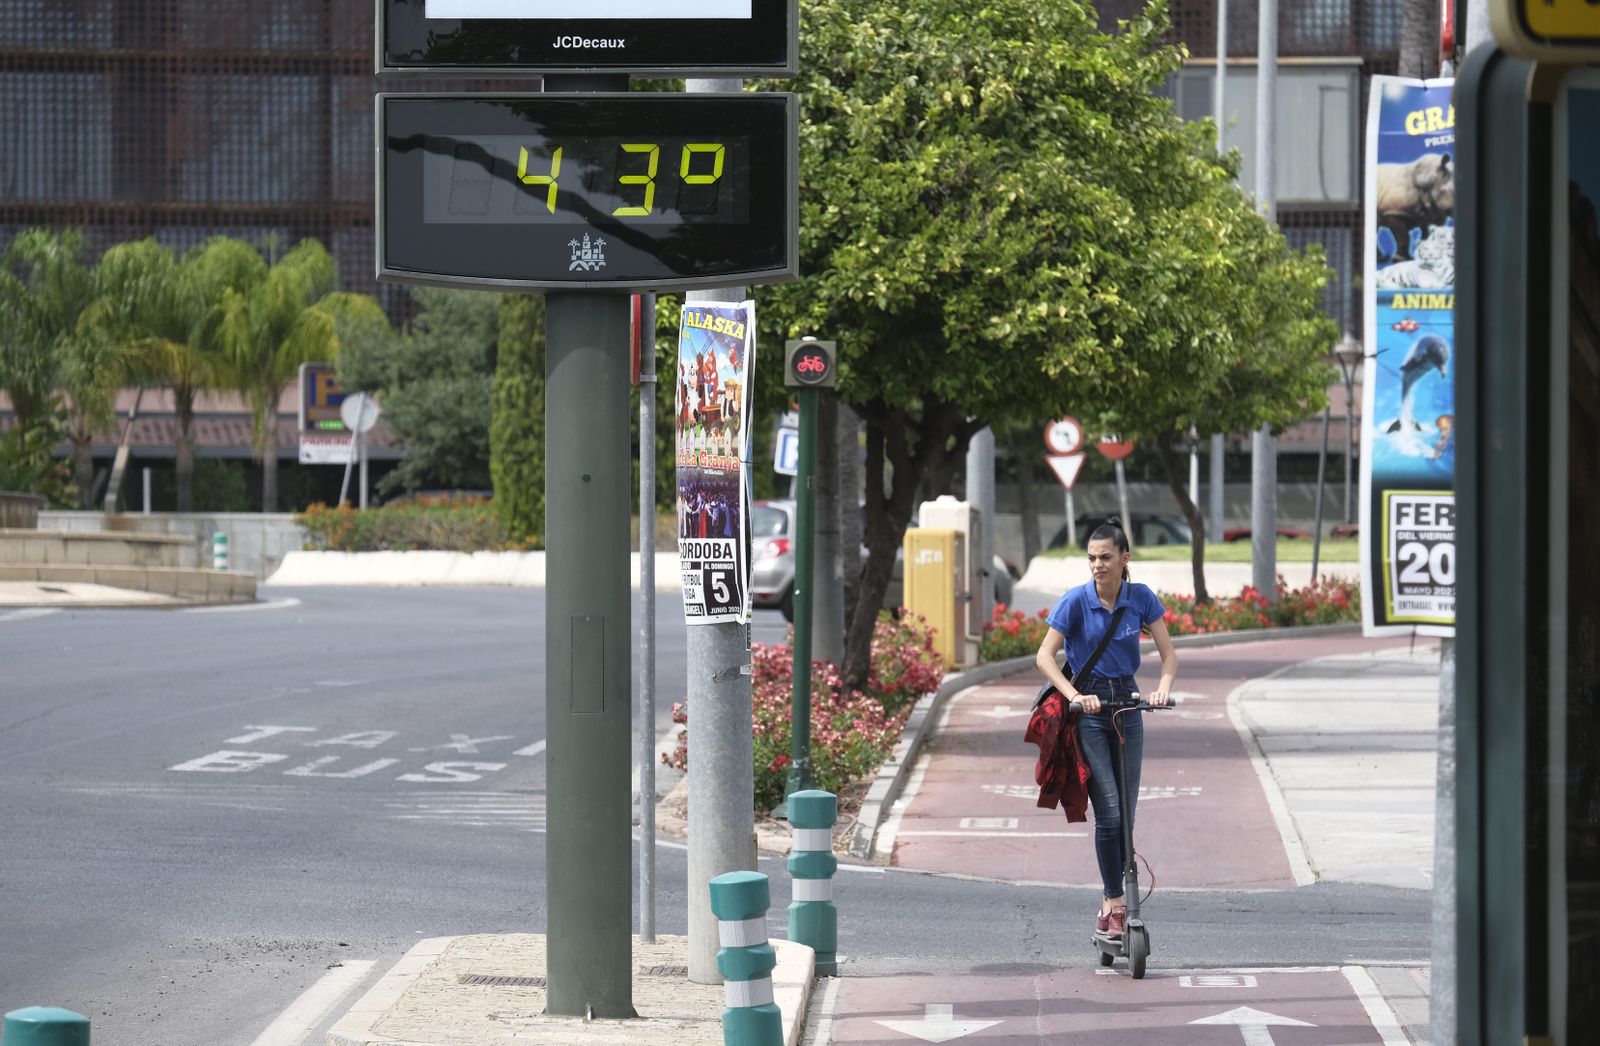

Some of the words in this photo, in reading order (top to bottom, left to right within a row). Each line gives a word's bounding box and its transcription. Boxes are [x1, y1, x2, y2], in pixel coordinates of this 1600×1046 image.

[552, 36, 626, 49] JCDecaux
[687, 311, 745, 340] ALASKA
[699, 450, 740, 473] Granja
[1398, 542, 1456, 586] 20
[711, 571, 731, 604] 5
[166, 749, 508, 783] BUS
